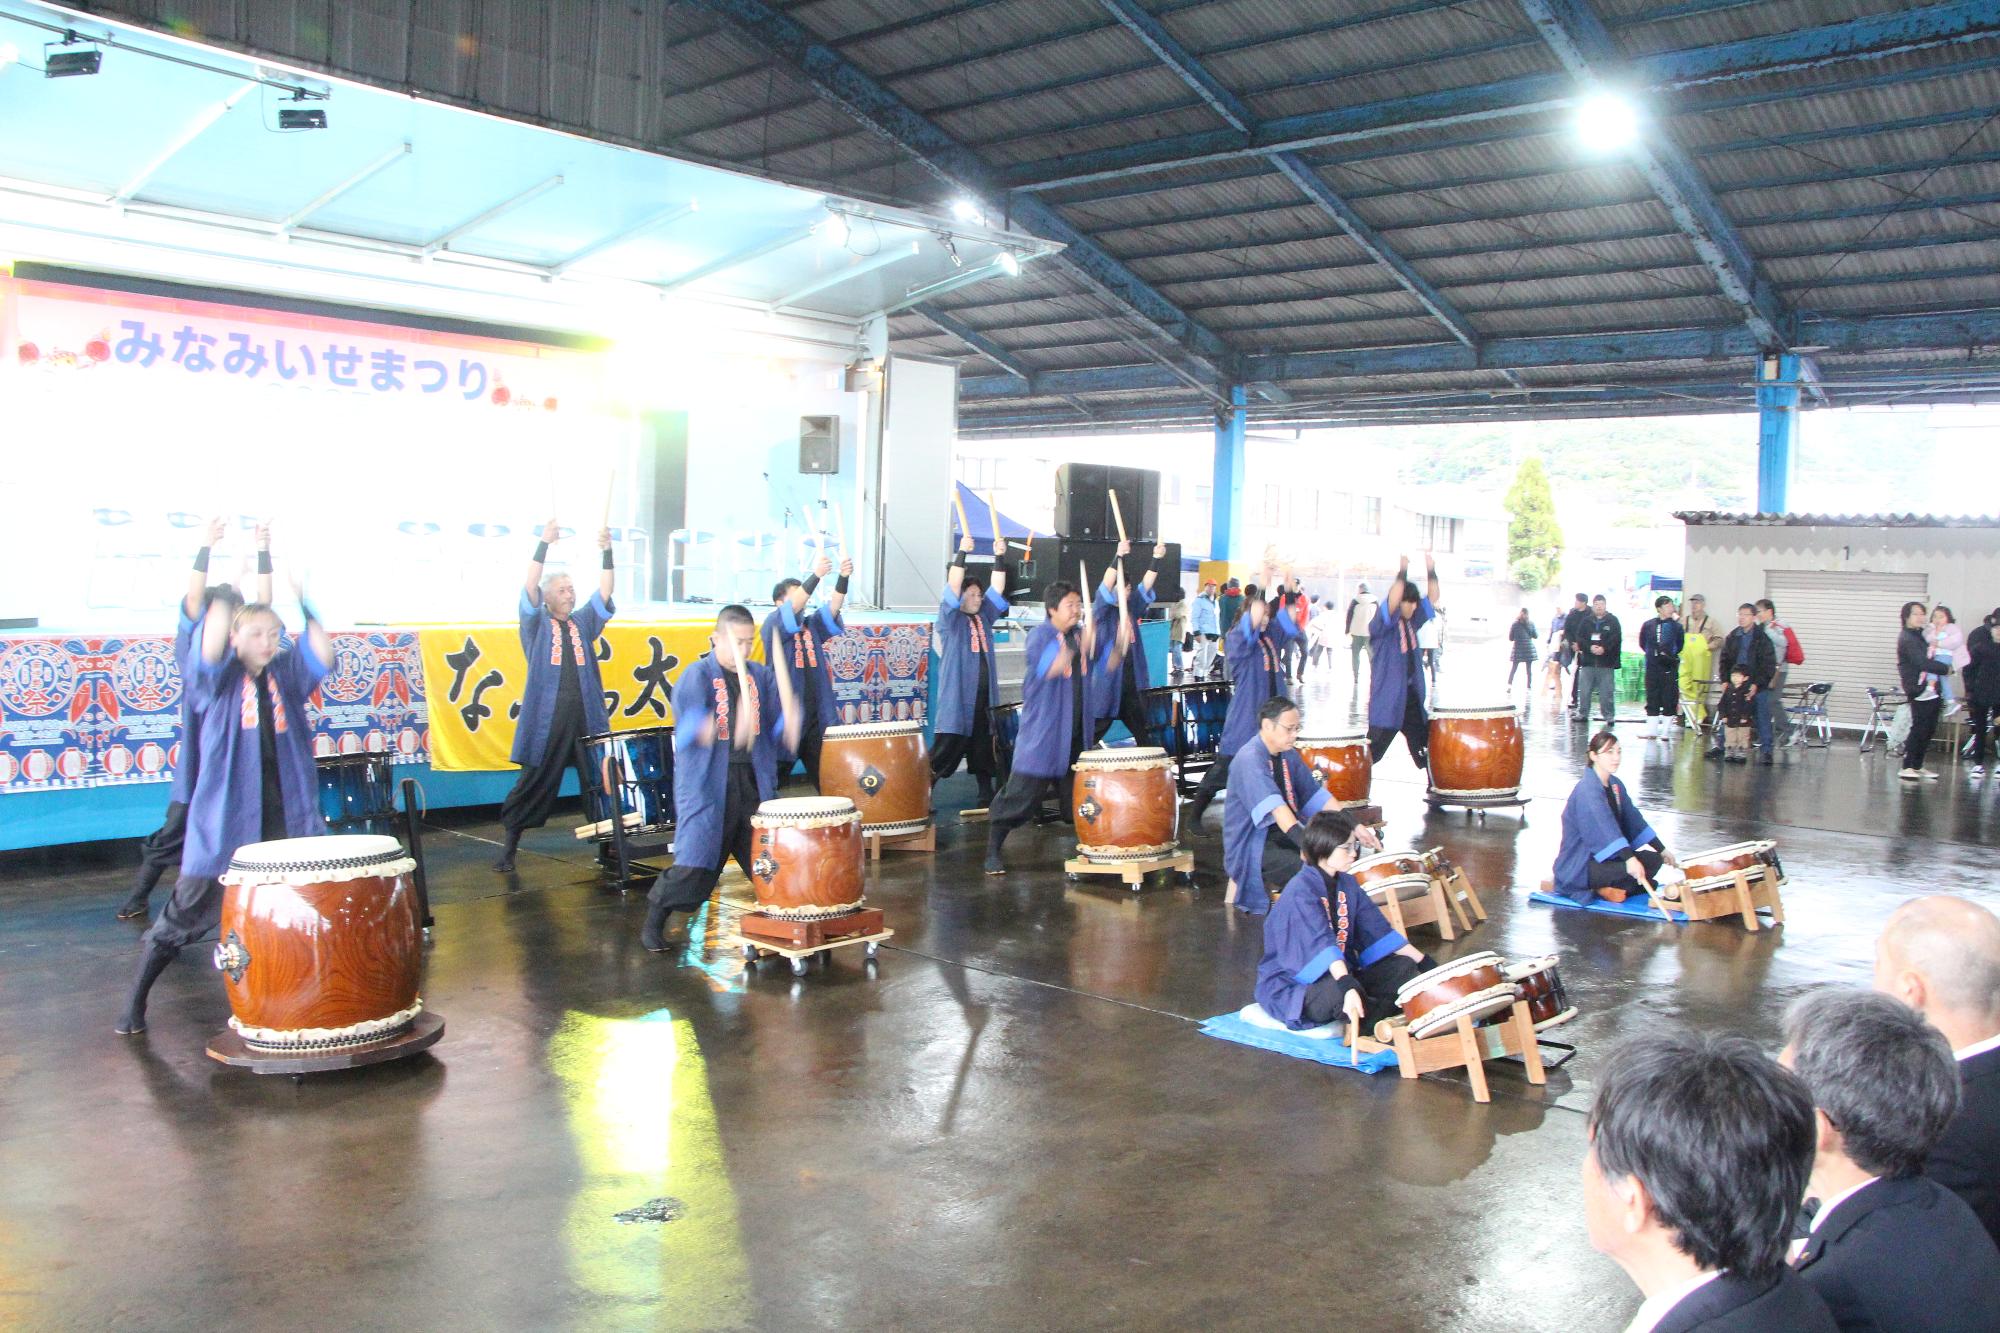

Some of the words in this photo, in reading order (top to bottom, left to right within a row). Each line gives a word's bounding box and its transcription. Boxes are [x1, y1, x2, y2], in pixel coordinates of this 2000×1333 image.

[115, 320, 489, 401] みなみいせまつり
